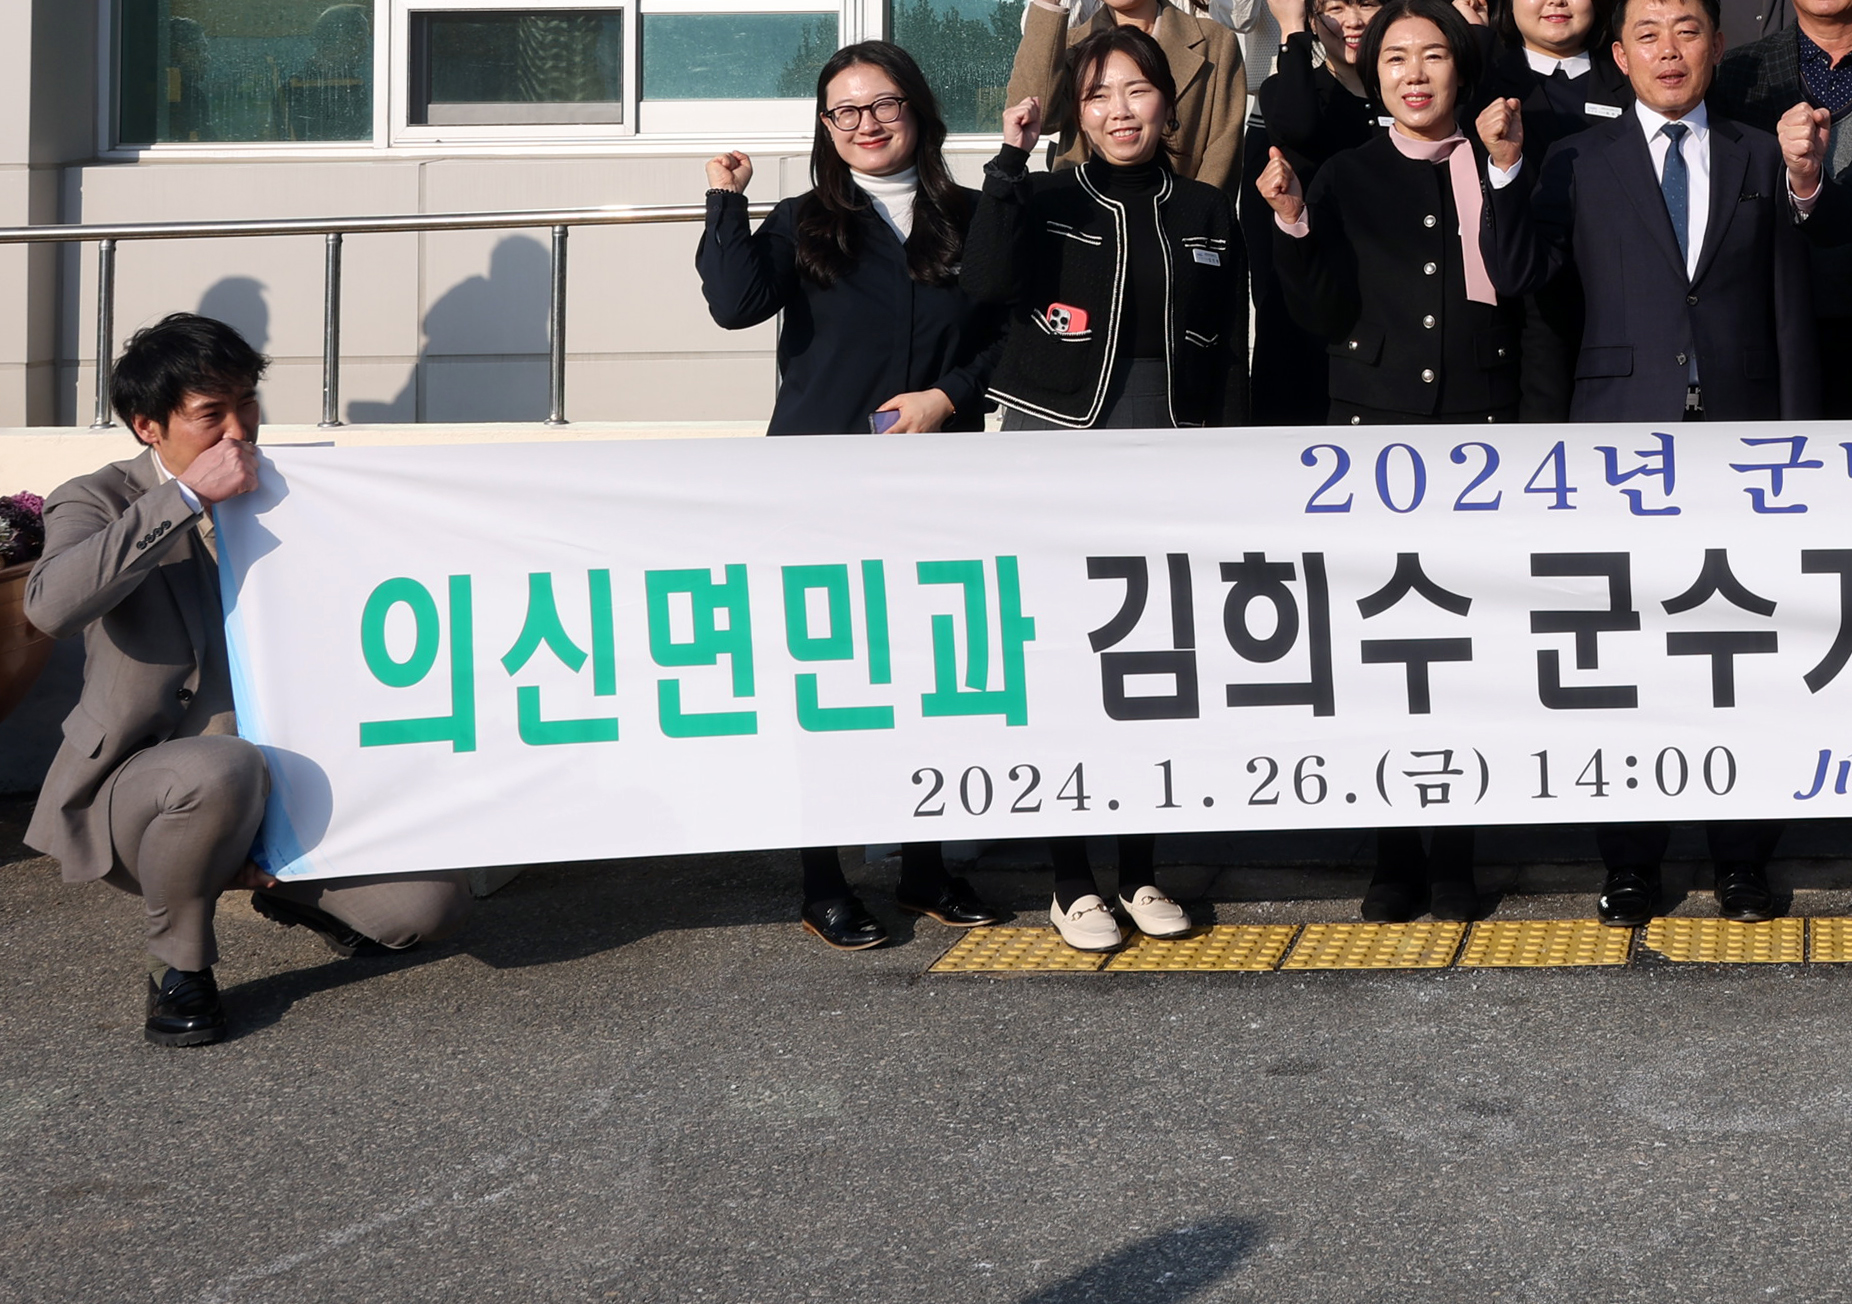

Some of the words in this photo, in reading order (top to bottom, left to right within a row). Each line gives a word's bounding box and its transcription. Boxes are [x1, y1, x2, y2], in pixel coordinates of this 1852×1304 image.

[1302, 433, 1681, 516] 2024년
[360, 555, 1036, 753] 의신면민과
[1086, 552, 1473, 720] 김희수
[1532, 746, 1737, 798] 14:00
